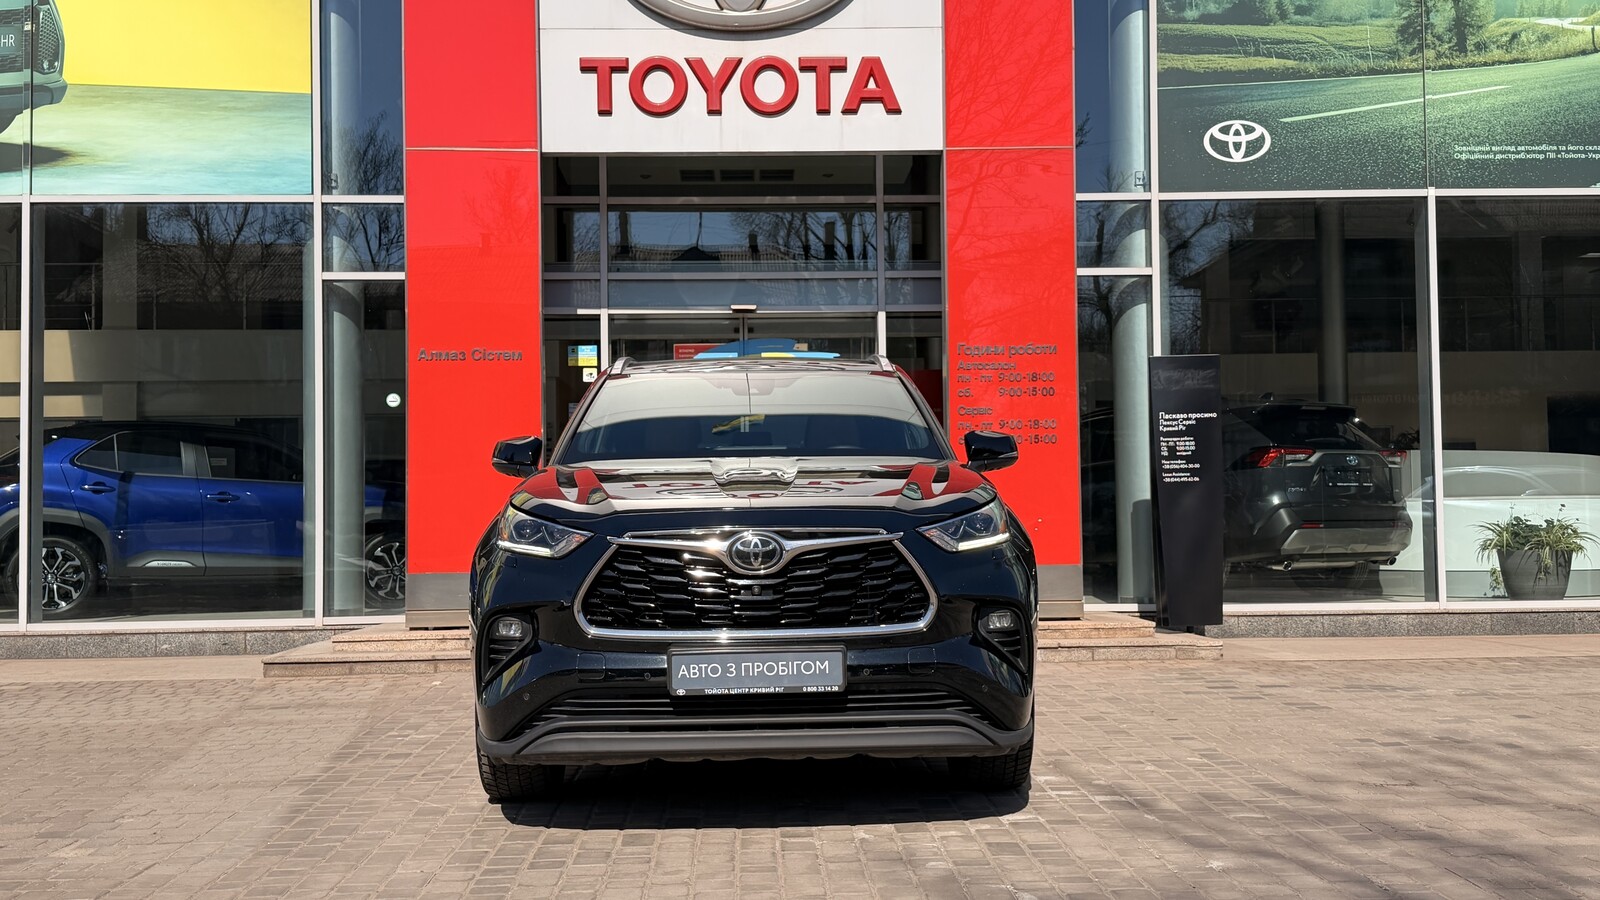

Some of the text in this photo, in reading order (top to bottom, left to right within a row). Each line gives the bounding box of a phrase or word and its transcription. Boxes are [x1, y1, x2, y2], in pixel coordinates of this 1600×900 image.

[579, 55, 903, 117] TOYOTA
[1517, 143, 1557, 151] автомобіля
[1567, 143, 1584, 152] його
[1454, 151, 1494, 160] Офіційний
[417, 348, 523, 362] Алмаз Сістем
[957, 343, 1057, 358] Години роботи
[957, 360, 1016, 371] Автосалон
[998, 372, 1055, 383] 9:00-18:00
[957, 386, 1055, 398] сб. 9:00-15:00
[957, 405, 993, 418] Сервіс
[998, 419, 1057, 430] 9:00-18:00
[677, 660, 829, 679] АВТО З ПРОБІГОМ
